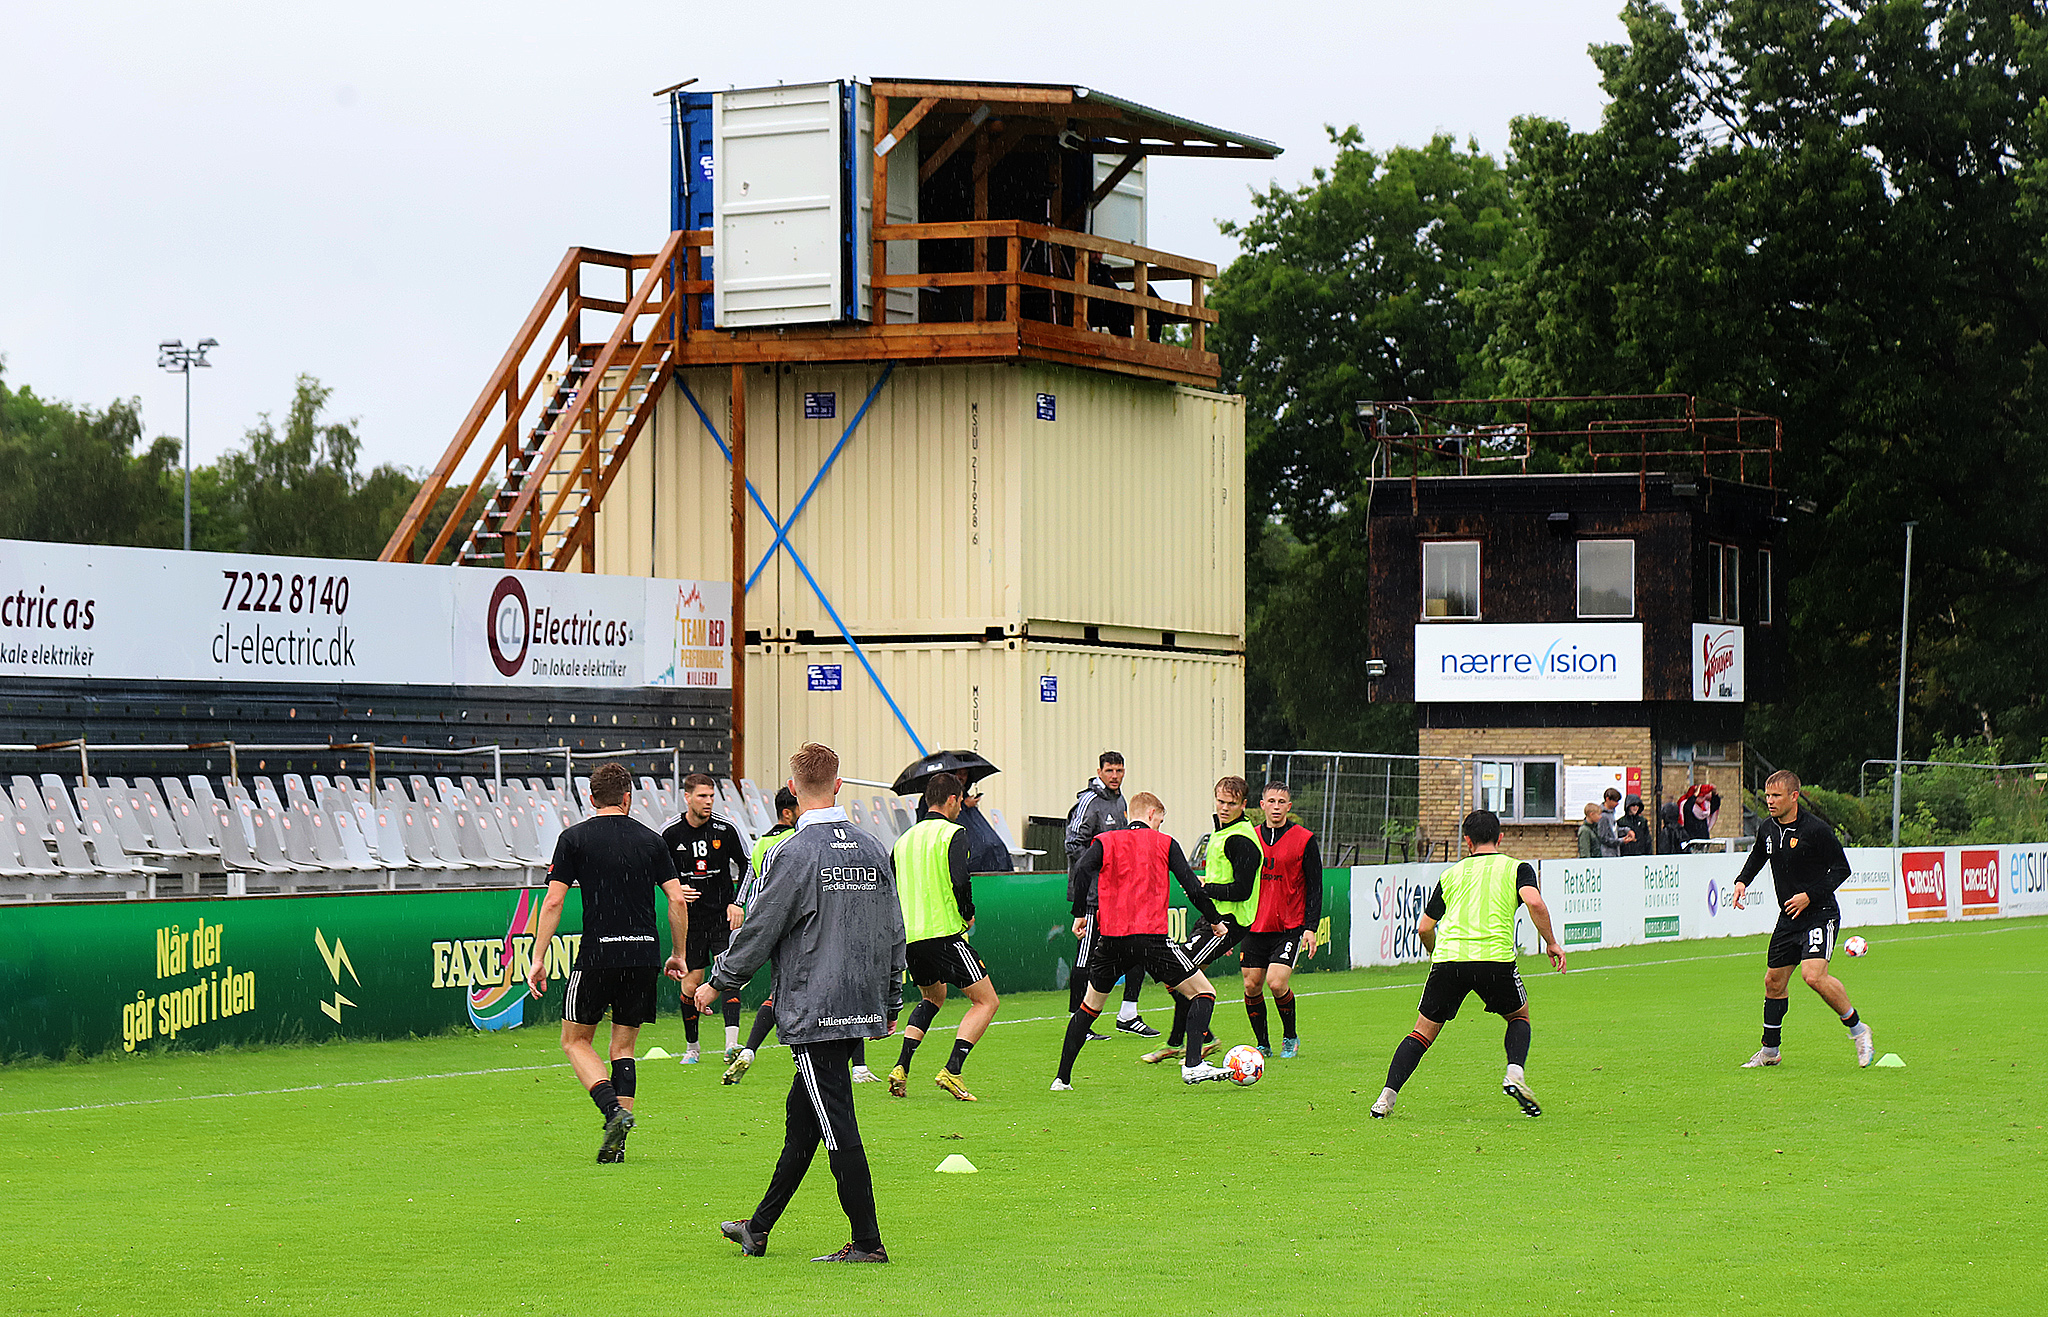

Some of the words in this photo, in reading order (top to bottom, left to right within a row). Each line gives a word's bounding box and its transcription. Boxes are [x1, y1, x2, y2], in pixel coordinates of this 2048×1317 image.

[222, 570, 283, 612] 7222
[289, 574, 349, 615] 8140
[212, 621, 356, 666] cl-electric.dk
[499, 606, 521, 645] CL
[532, 606, 602, 646] Electric
[680, 618, 706, 646] TEAM
[708, 619, 725, 647] RED
[31, 643, 94, 666] elektriker
[532, 658, 548, 675] Din
[549, 658, 580, 677] lokale
[582, 658, 626, 677] elektriker
[1441, 636, 1617, 677] nærrevision
[692, 841, 708, 857] 18
[1644, 864, 1680, 889] Ret&Råd
[1907, 868, 1936, 894] CIRCLE
[1963, 867, 1987, 891] CIRCLE
[2010, 851, 2048, 894] ensur
[156, 923, 189, 979] Når
[192, 917, 223, 971] der
[1809, 928, 1824, 945] 19
[431, 938, 504, 988] FAXE
[122, 990, 155, 1053] går
[158, 976, 208, 1040] sport
[211, 971, 218, 1021] i
[220, 966, 255, 1018] den
